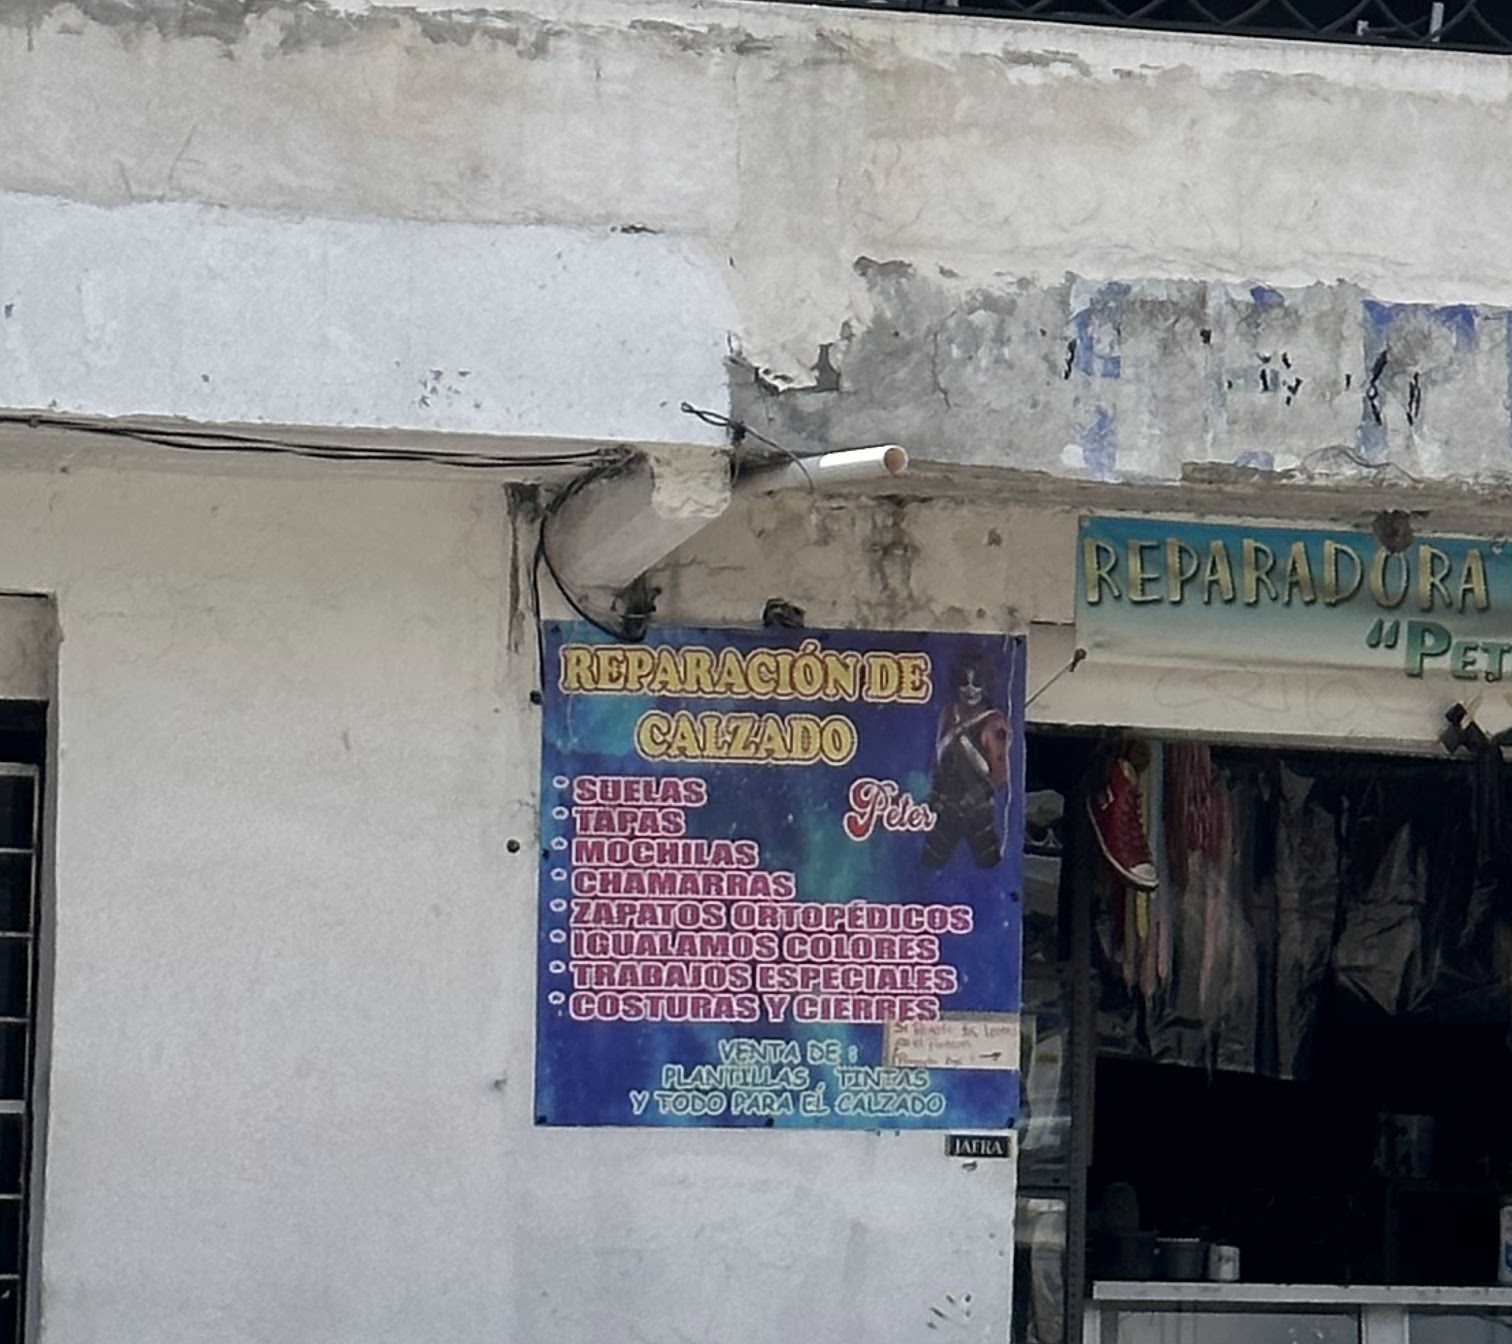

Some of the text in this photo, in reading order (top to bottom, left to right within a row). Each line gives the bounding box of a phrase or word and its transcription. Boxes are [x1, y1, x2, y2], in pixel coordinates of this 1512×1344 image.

[1083, 534, 1491, 617] REPARADORA
[558, 641, 931, 704] REPARACIÓN DE
[635, 711, 857, 765] CALZADO
[573, 776, 707, 806] SUELAS
[573, 807, 685, 836] TAPAS
[843, 778, 936, 842] Peter
[572, 838, 759, 868] MOCHILAS
[571, 869, 795, 899] CHAMARRAS
[569, 900, 973, 933] ZAPATOS ORTOPÉDICOS
[570, 931, 940, 962] IGUALAMOS COLORES
[569, 962, 957, 994] TRABAJOS ESPECIALES
[569, 993, 940, 1023] COSTURAS Y CIERRES
[719, 1040, 842, 1065] VENTA DE
[662, 1066, 929, 1090] PLANTILLAS TINTAS
[631, 1091, 946, 1117] Y TODO PARA EL CALZADO
[954, 1139, 1003, 1155] JAFRA
